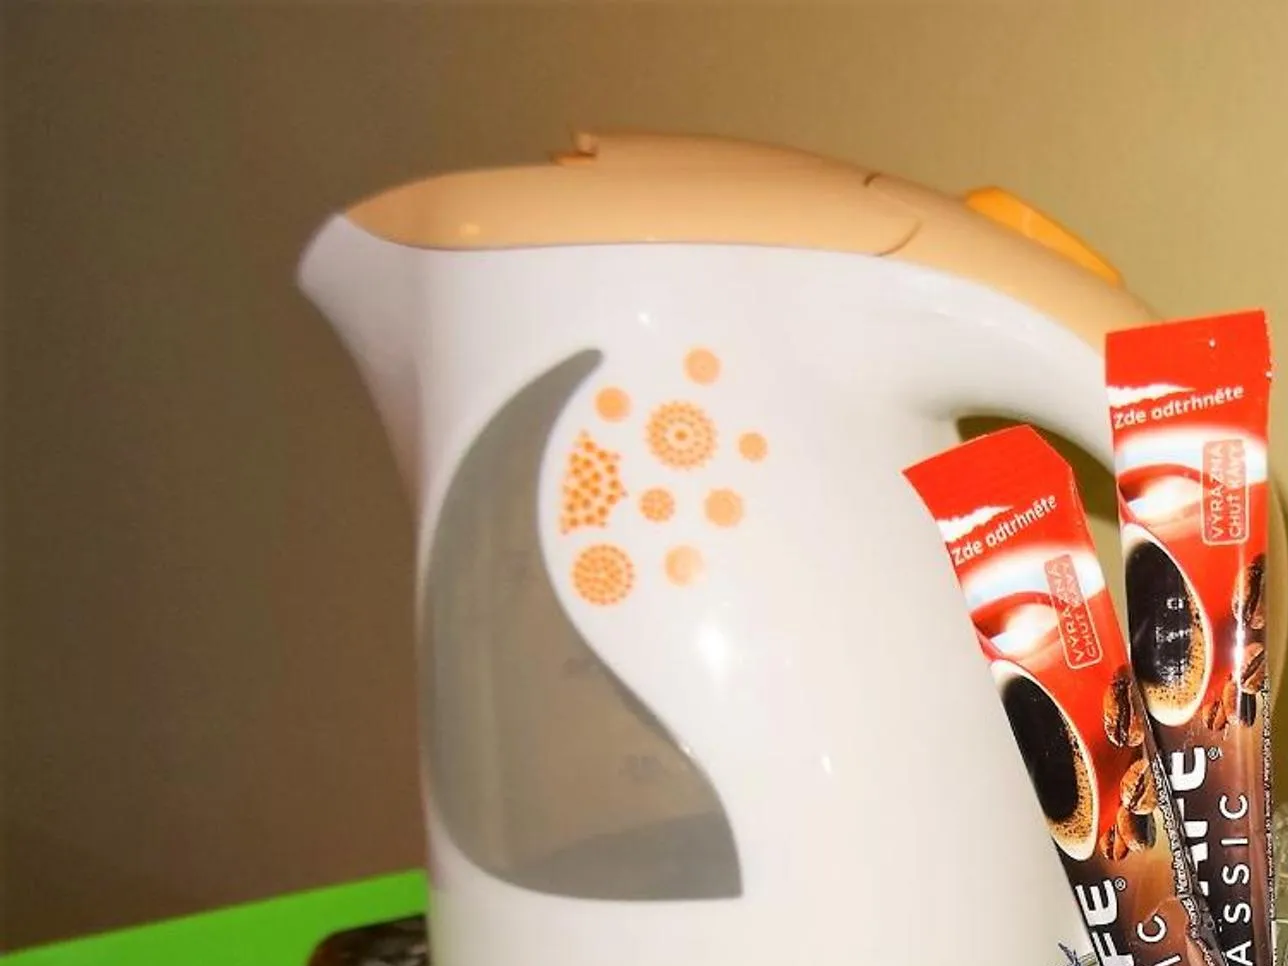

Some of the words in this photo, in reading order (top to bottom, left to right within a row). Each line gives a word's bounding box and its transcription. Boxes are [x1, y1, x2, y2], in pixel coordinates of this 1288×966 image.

[1113, 408, 1147, 430] Zde
[1151, 385, 1245, 420] odtrhněte
[952, 539, 983, 567] Zde
[985, 494, 1058, 547] odtrhněte
